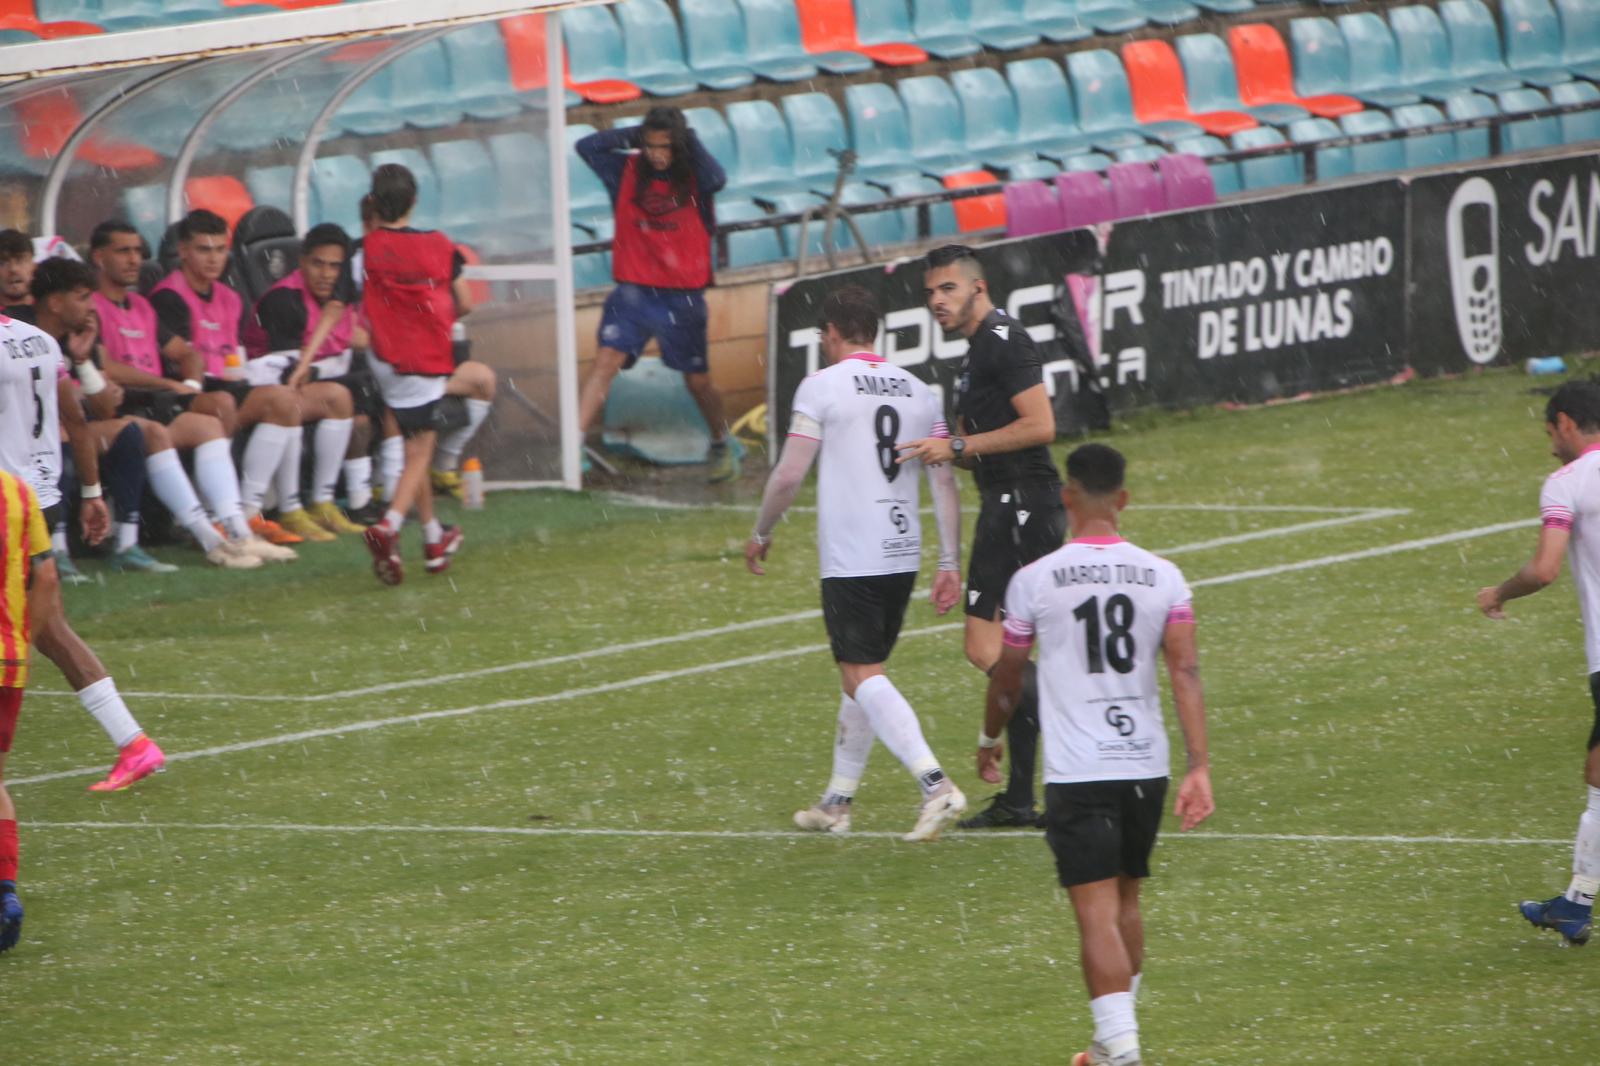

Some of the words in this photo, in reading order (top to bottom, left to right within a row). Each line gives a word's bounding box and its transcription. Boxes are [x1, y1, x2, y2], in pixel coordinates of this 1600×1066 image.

[1160, 256, 1268, 310] TINTADO
[1271, 252, 1291, 291] Y
[1294, 236, 1394, 288] CAMBIO
[1198, 309, 1238, 359] DE
[1245, 287, 1354, 353] LUNAS
[852, 374, 914, 398] AMARO
[874, 403, 900, 484] 8
[1052, 564, 1111, 589] MARCO
[1114, 564, 1156, 588] TULIO
[1072, 593, 1136, 675] 18
